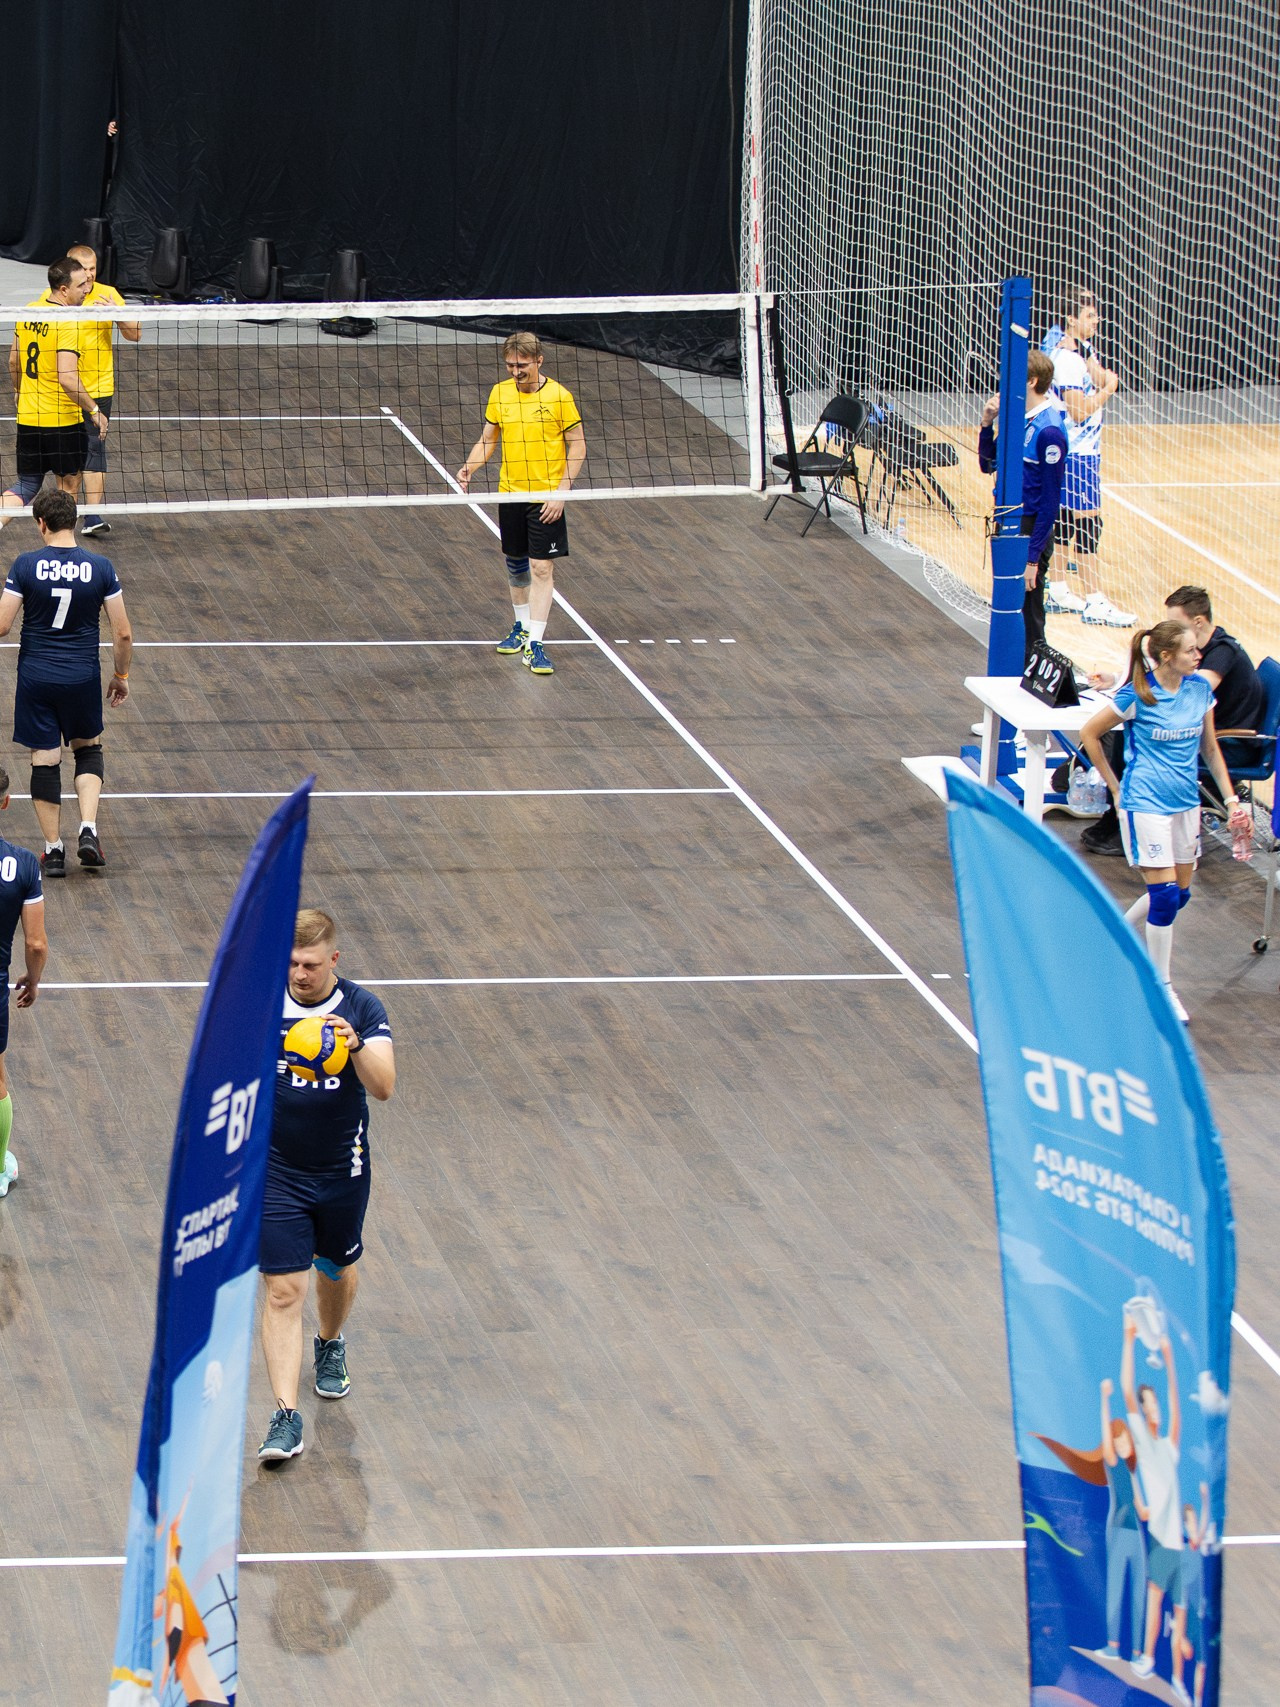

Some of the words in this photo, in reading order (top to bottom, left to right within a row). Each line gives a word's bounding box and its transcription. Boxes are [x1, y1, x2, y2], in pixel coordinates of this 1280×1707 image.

[26, 342, 40, 379] 8
[36, 559, 92, 582] СЗФО
[51, 588, 72, 629] 7
